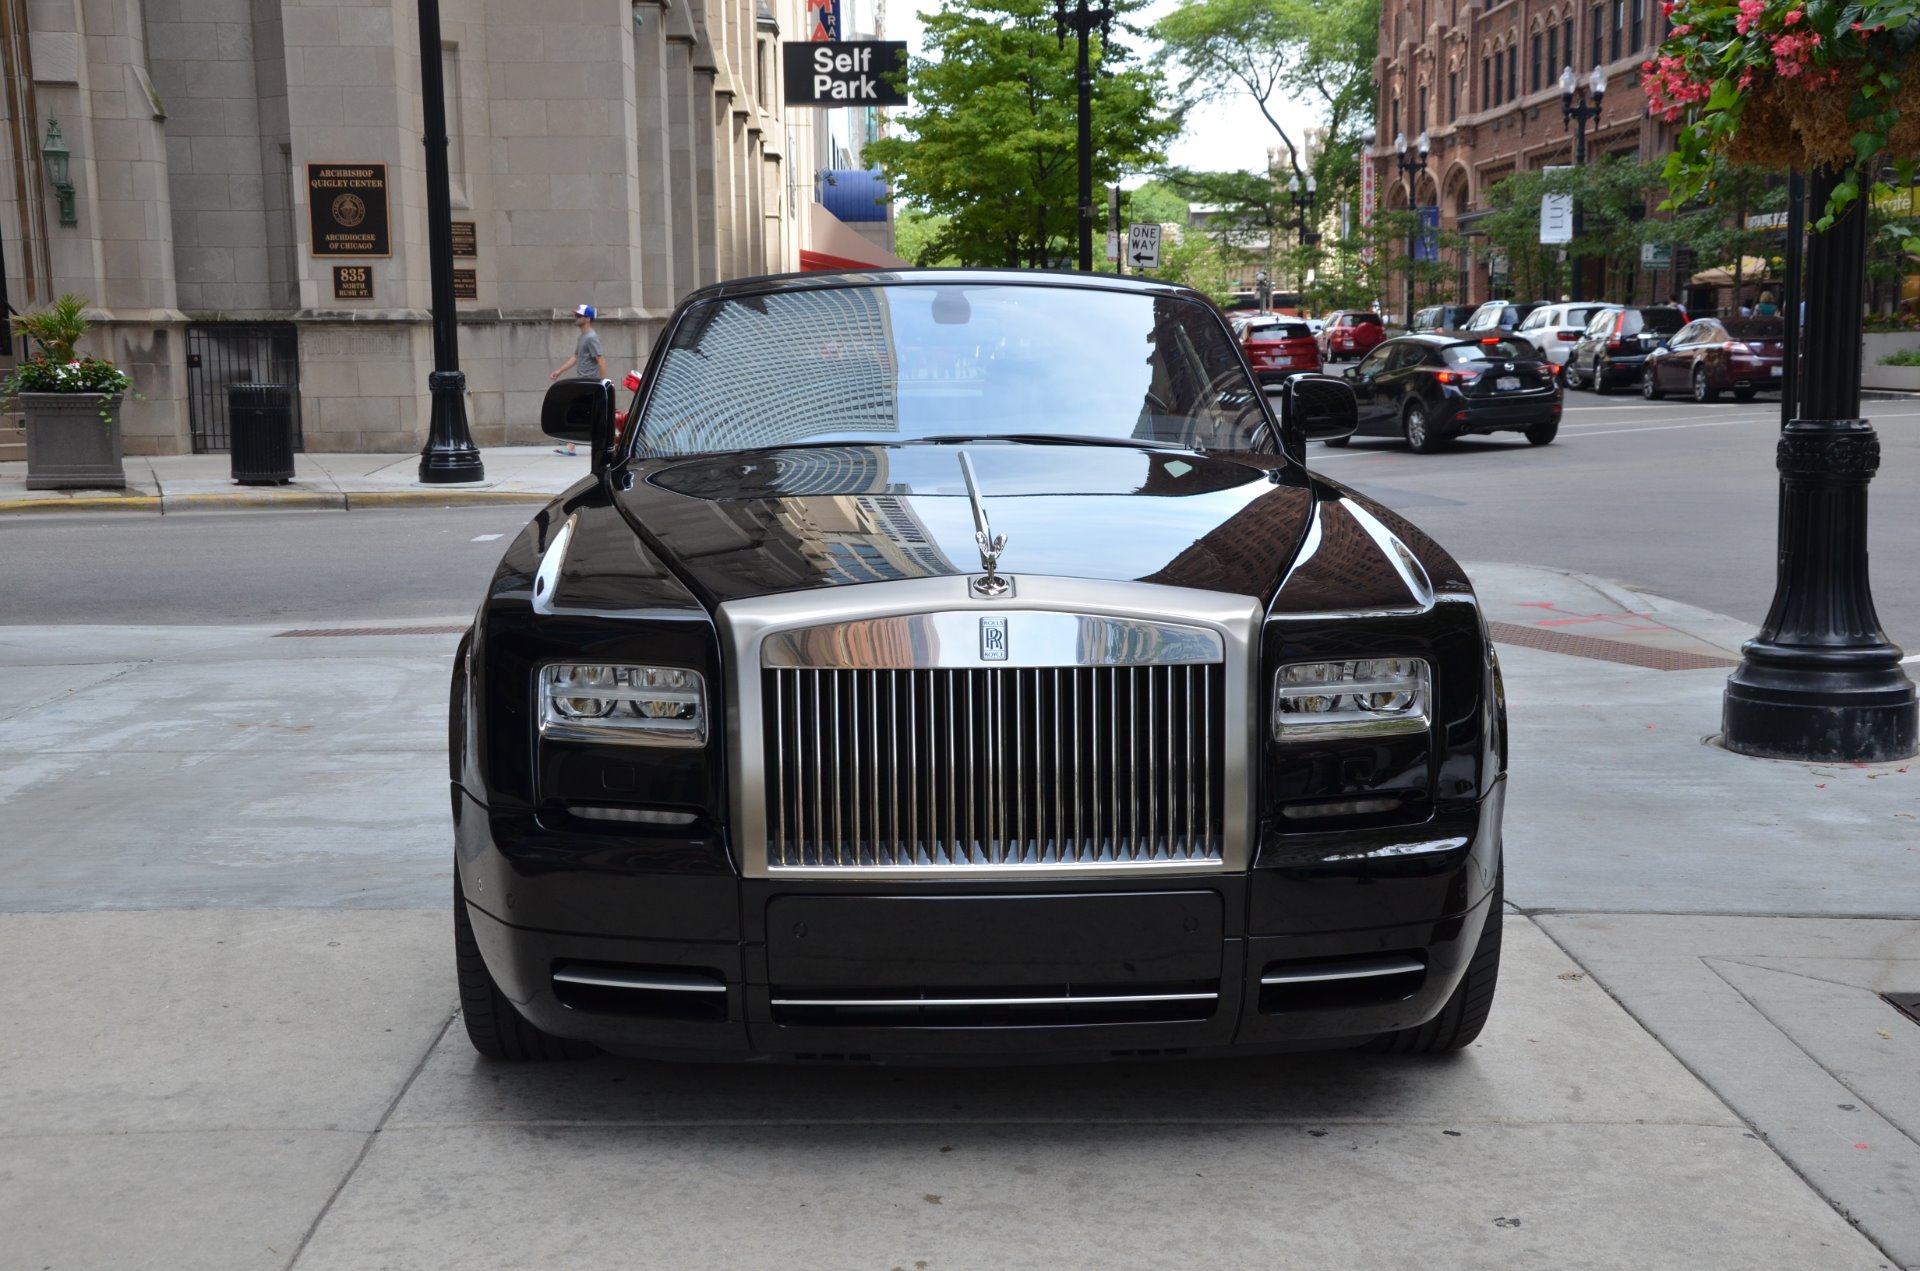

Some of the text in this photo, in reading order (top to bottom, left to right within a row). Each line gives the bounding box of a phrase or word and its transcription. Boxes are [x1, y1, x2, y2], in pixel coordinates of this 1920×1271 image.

[814, 47, 871, 73] Self
[814, 74, 877, 99] Park
[319, 169, 374, 177] ARCHBISHOP
[311, 179, 384, 188] QUIGLEY CENTER
[325, 233, 376, 241] ARCHDIOCESE
[1133, 227, 1157, 238] ONE
[1132, 239, 1156, 250] WAY
[340, 268, 366, 282] 835
